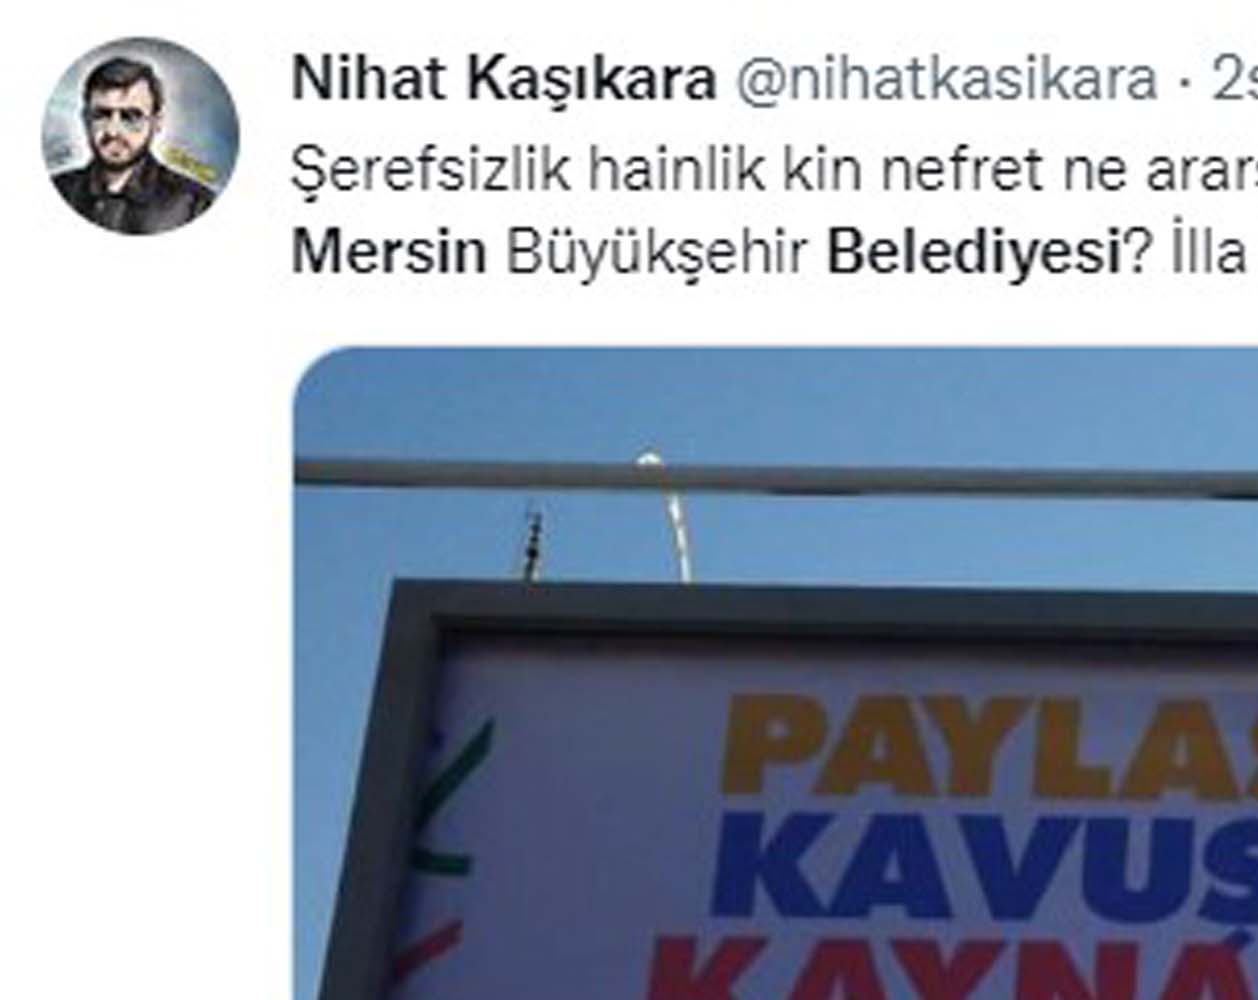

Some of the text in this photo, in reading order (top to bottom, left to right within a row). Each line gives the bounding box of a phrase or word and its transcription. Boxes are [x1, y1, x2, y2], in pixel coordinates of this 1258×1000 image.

[293, 53, 447, 100] Nihat
[468, 53, 716, 113] Kaşıkara
[738, 54, 1157, 108] @nihatkasikara
[291, 144, 571, 203] Şerefsizlik
[590, 144, 766, 191] hainlik
[785, 144, 861, 191] kin
[883, 144, 1043, 191] nefret
[1065, 156, 1126, 191] ne
[293, 226, 486, 274] Mersin
[509, 226, 808, 286] Büyükşehir
[829, 226, 1153, 286] Belediyesi?
[1173, 216, 1246, 274] İlla
